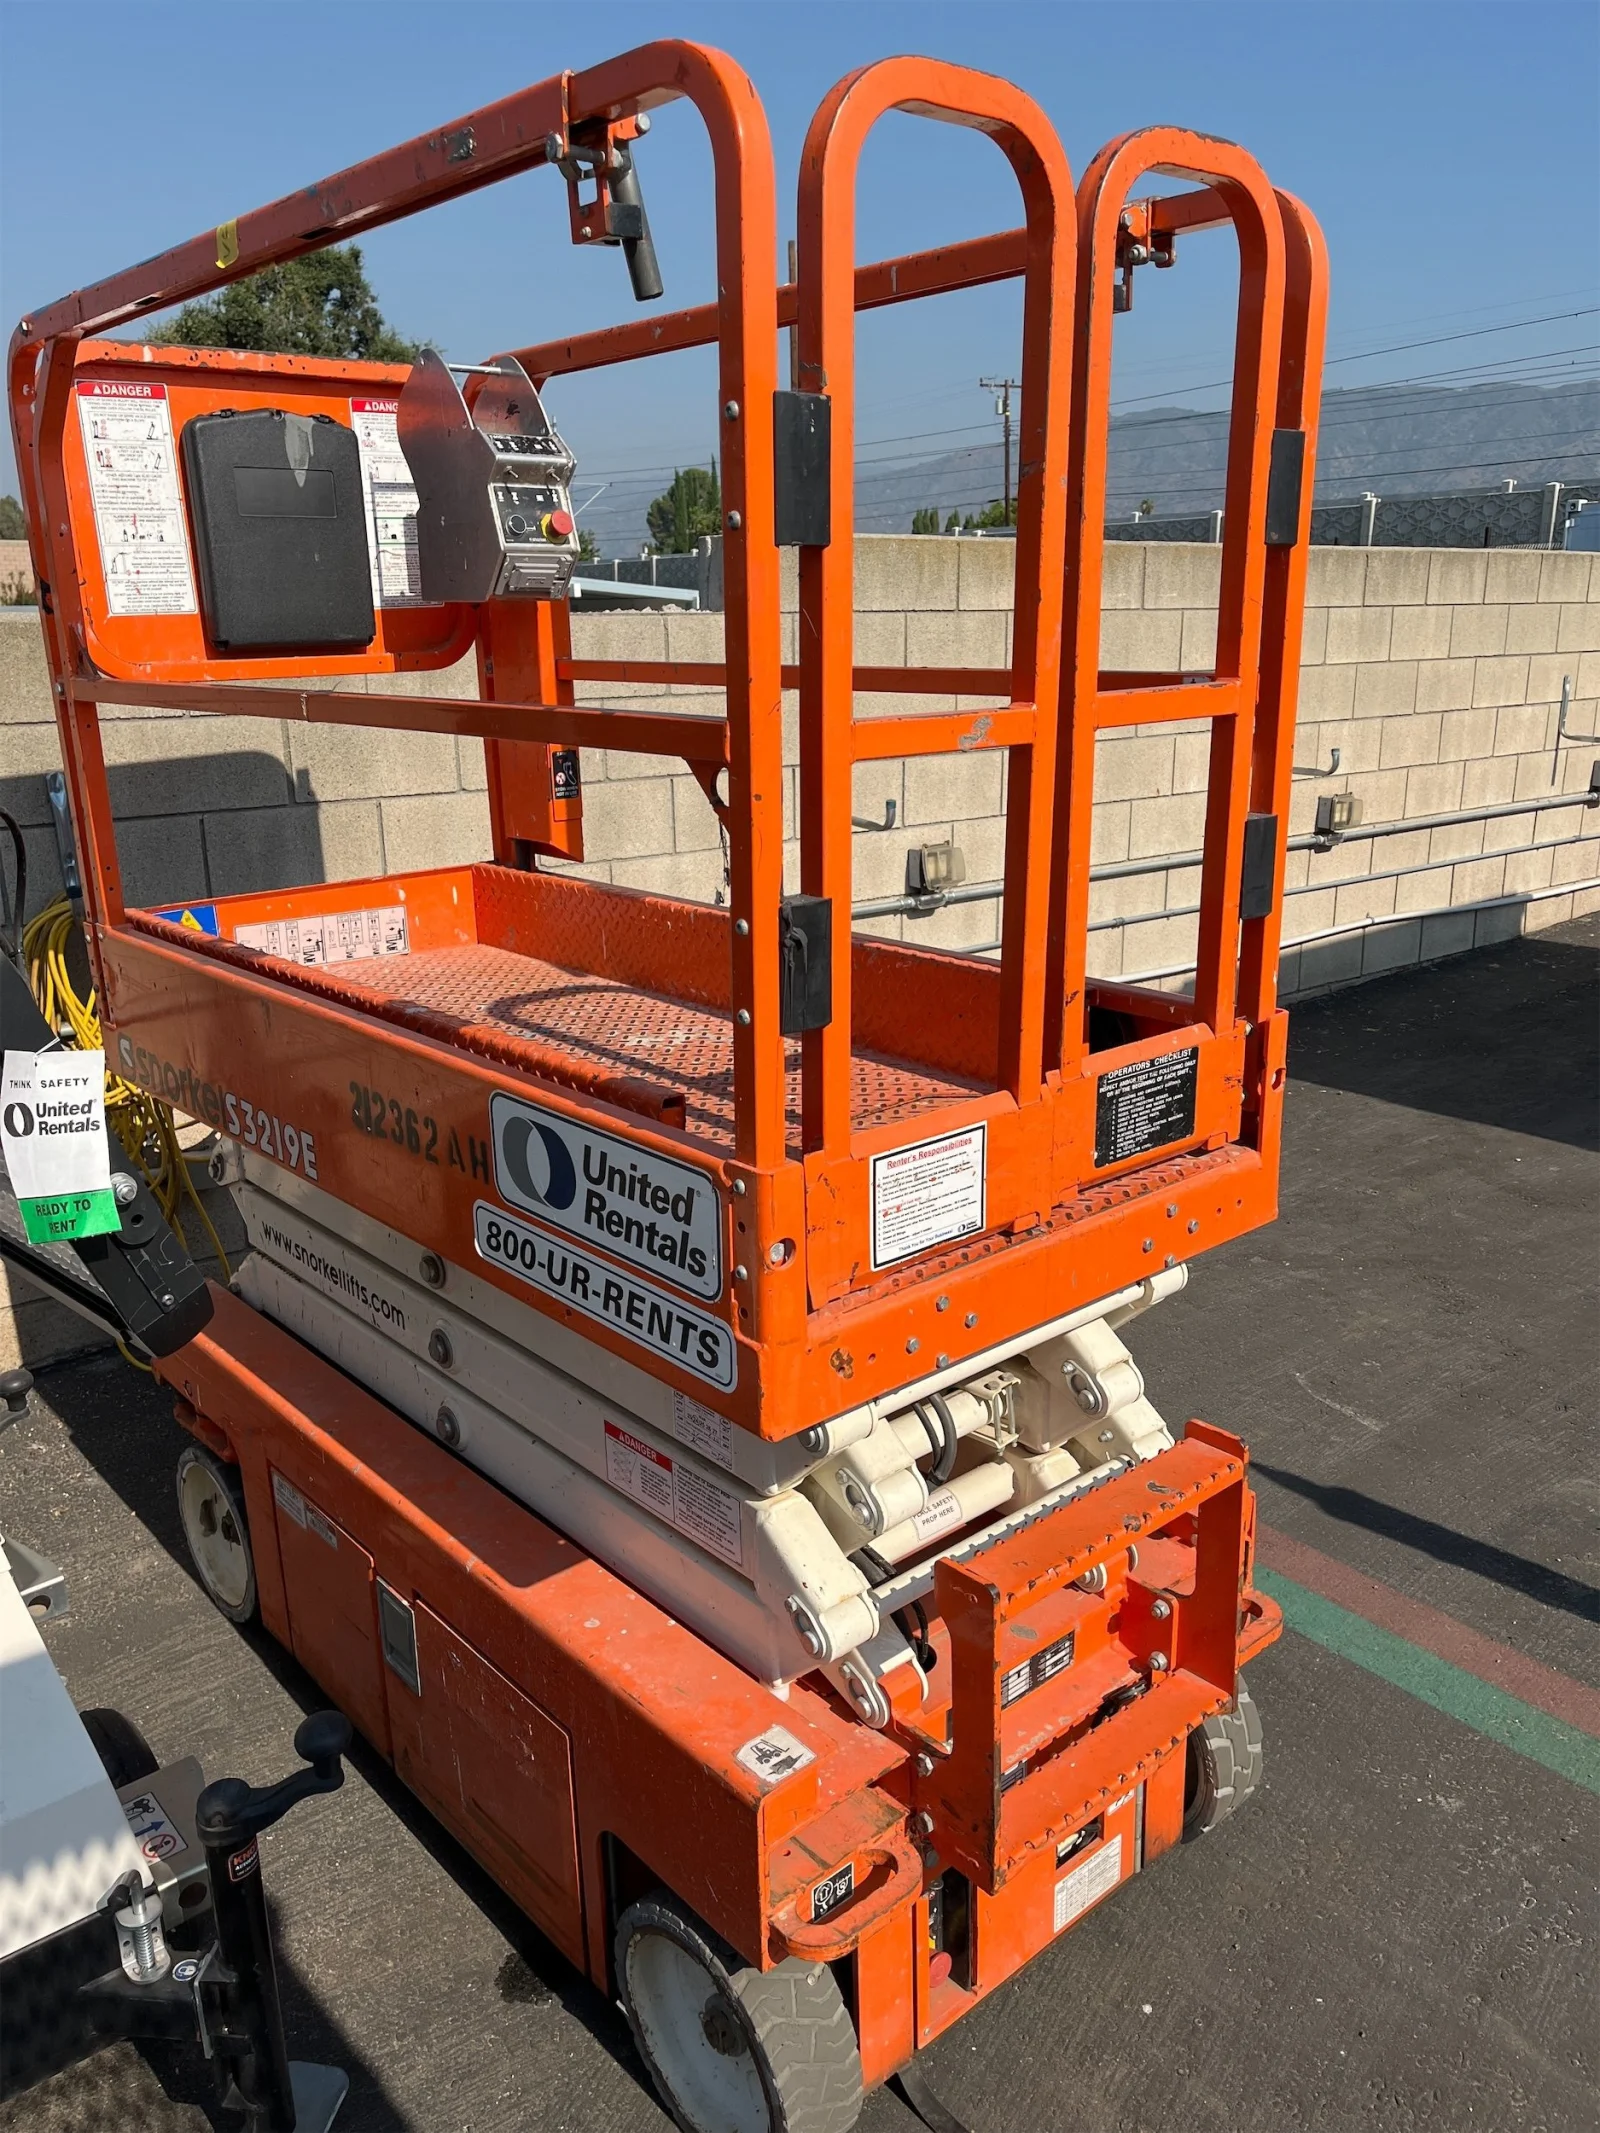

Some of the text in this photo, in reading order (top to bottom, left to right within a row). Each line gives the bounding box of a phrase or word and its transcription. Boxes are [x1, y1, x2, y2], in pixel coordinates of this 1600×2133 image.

[102, 384, 152, 397] DANGER
[372, 401, 399, 412] DANG
[1108, 1048, 1192, 1079] OPERATORS CHECKLIST
[9, 1077, 89, 1089] THINK SAFETY
[135, 1047, 229, 1132] snorkel
[1099, 1082, 1118, 1093] INSPECT
[1137, 1072, 1148, 1081] TEST
[1131, 1077, 1156, 1090] BEGINNING
[1164, 1071, 1176, 1080] EACH
[36, 1099, 93, 1118] United
[38, 1118, 101, 1136] Rentals
[223, 1091, 319, 1181] S3219E
[887, 1137, 972, 1169] Renter's Responsibilities
[582, 1144, 695, 1227] United
[35, 1198, 91, 1217] READY TO
[48, 1219, 77, 1234] RENT
[583, 1188, 707, 1278] Rentals
[261, 1220, 405, 1330] www.snorkellifts.com
[485, 1220, 721, 1369] 800-UR-RENTS
[624, 1434, 658, 1462] DANGER
[932, 1494, 954, 1509] SAFETY
[922, 1505, 955, 1526] PROP HERE
